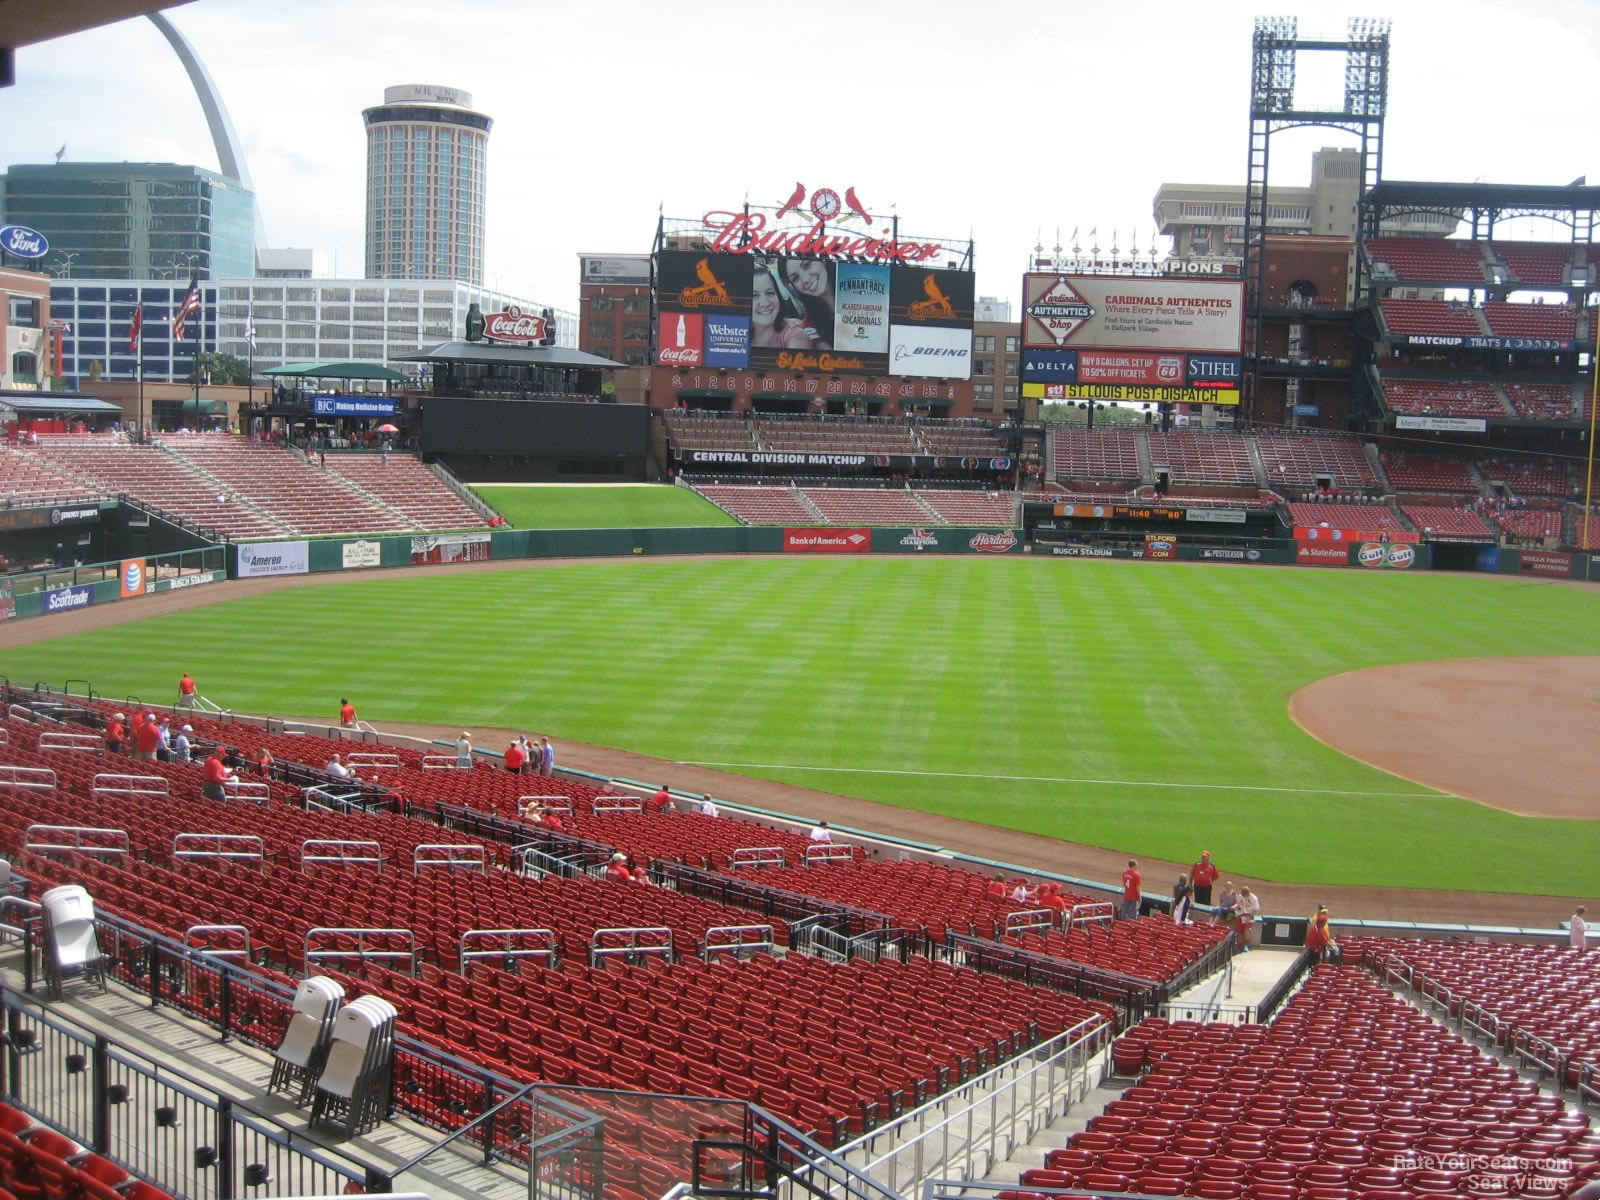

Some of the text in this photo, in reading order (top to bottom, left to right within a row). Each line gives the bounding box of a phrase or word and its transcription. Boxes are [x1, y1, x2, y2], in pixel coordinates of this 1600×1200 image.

[10, 229, 40, 252] Ford
[703, 211, 942, 261] Budweiser
[1050, 257, 1223, 273] WORLD CHAMPIONS
[840, 279, 886, 295] PENNANT RACE
[680, 289, 730, 308] Cardinals
[1043, 293, 1080, 304] Cardinals
[1105, 295, 1232, 308] CARDINALS AUTHENTICS
[1034, 306, 1089, 316] AUTHENTICS
[1105, 305, 1227, 318] Where Every Piece Tells A Story!
[491, 316, 540, 336] Coca-Cola
[842, 315, 882, 326] @CARDINALS
[1049, 318, 1073, 331] Shop
[709, 324, 749, 336] Webster
[709, 335, 748, 343] UNIVERSITY
[1408, 335, 1463, 346] MATCHUP
[1470, 337, 1500, 347] THAT'S
[660, 348, 701, 363] Coca-Cola
[913, 347, 969, 357] BOEING
[1037, 362, 1075, 371] DELTA
[1081, 357, 1095, 366] BUY
[1132, 358, 1145, 367] GET
[1145, 359, 1153, 367] UP
[1189, 359, 1239, 376] STIFEL
[1082, 368, 1090, 377] TO
[1091, 368, 1106, 377] 50%
[1107, 369, 1119, 377] OFF
[1161, 366, 1176, 377] 66
[695, 376, 700, 388] 1
[709, 376, 718, 389] 2
[727, 377, 736, 389] 6
[745, 378, 753, 390] 9
[763, 378, 774, 391] 10
[784, 379, 797, 392] 14
[806, 380, 818, 393] 17
[827, 381, 842, 394] 20
[851, 382, 867, 395] 24
[876, 383, 891, 396] 42
[899, 384, 914, 397] 45
[923, 385, 937, 397] 85
[1069, 385, 1218, 402] ST. LOUIS POST-DISPATCH
[317, 400, 394, 412] BJC Making Medicine Better
[693, 452, 866, 465] CENTRAL DIVISION MATCHUP
[789, 536, 847, 545] Bank of America
[1053, 547, 1078, 555] BUSCH
[1212, 549, 1244, 558] POSTSEASON
[1360, 548, 1384, 561] Gulf
[1388, 550, 1412, 562] Gulf
[251, 555, 282, 566] Ameren
[1522, 555, 1569, 565] WELLS FARGO
[1533, 563, 1569, 571] ADVISORS
[171, 573, 214, 589] BUSCH STADIUM
[49, 589, 89, 609] Scottrade
[541, 1162, 553, 1177] 161
